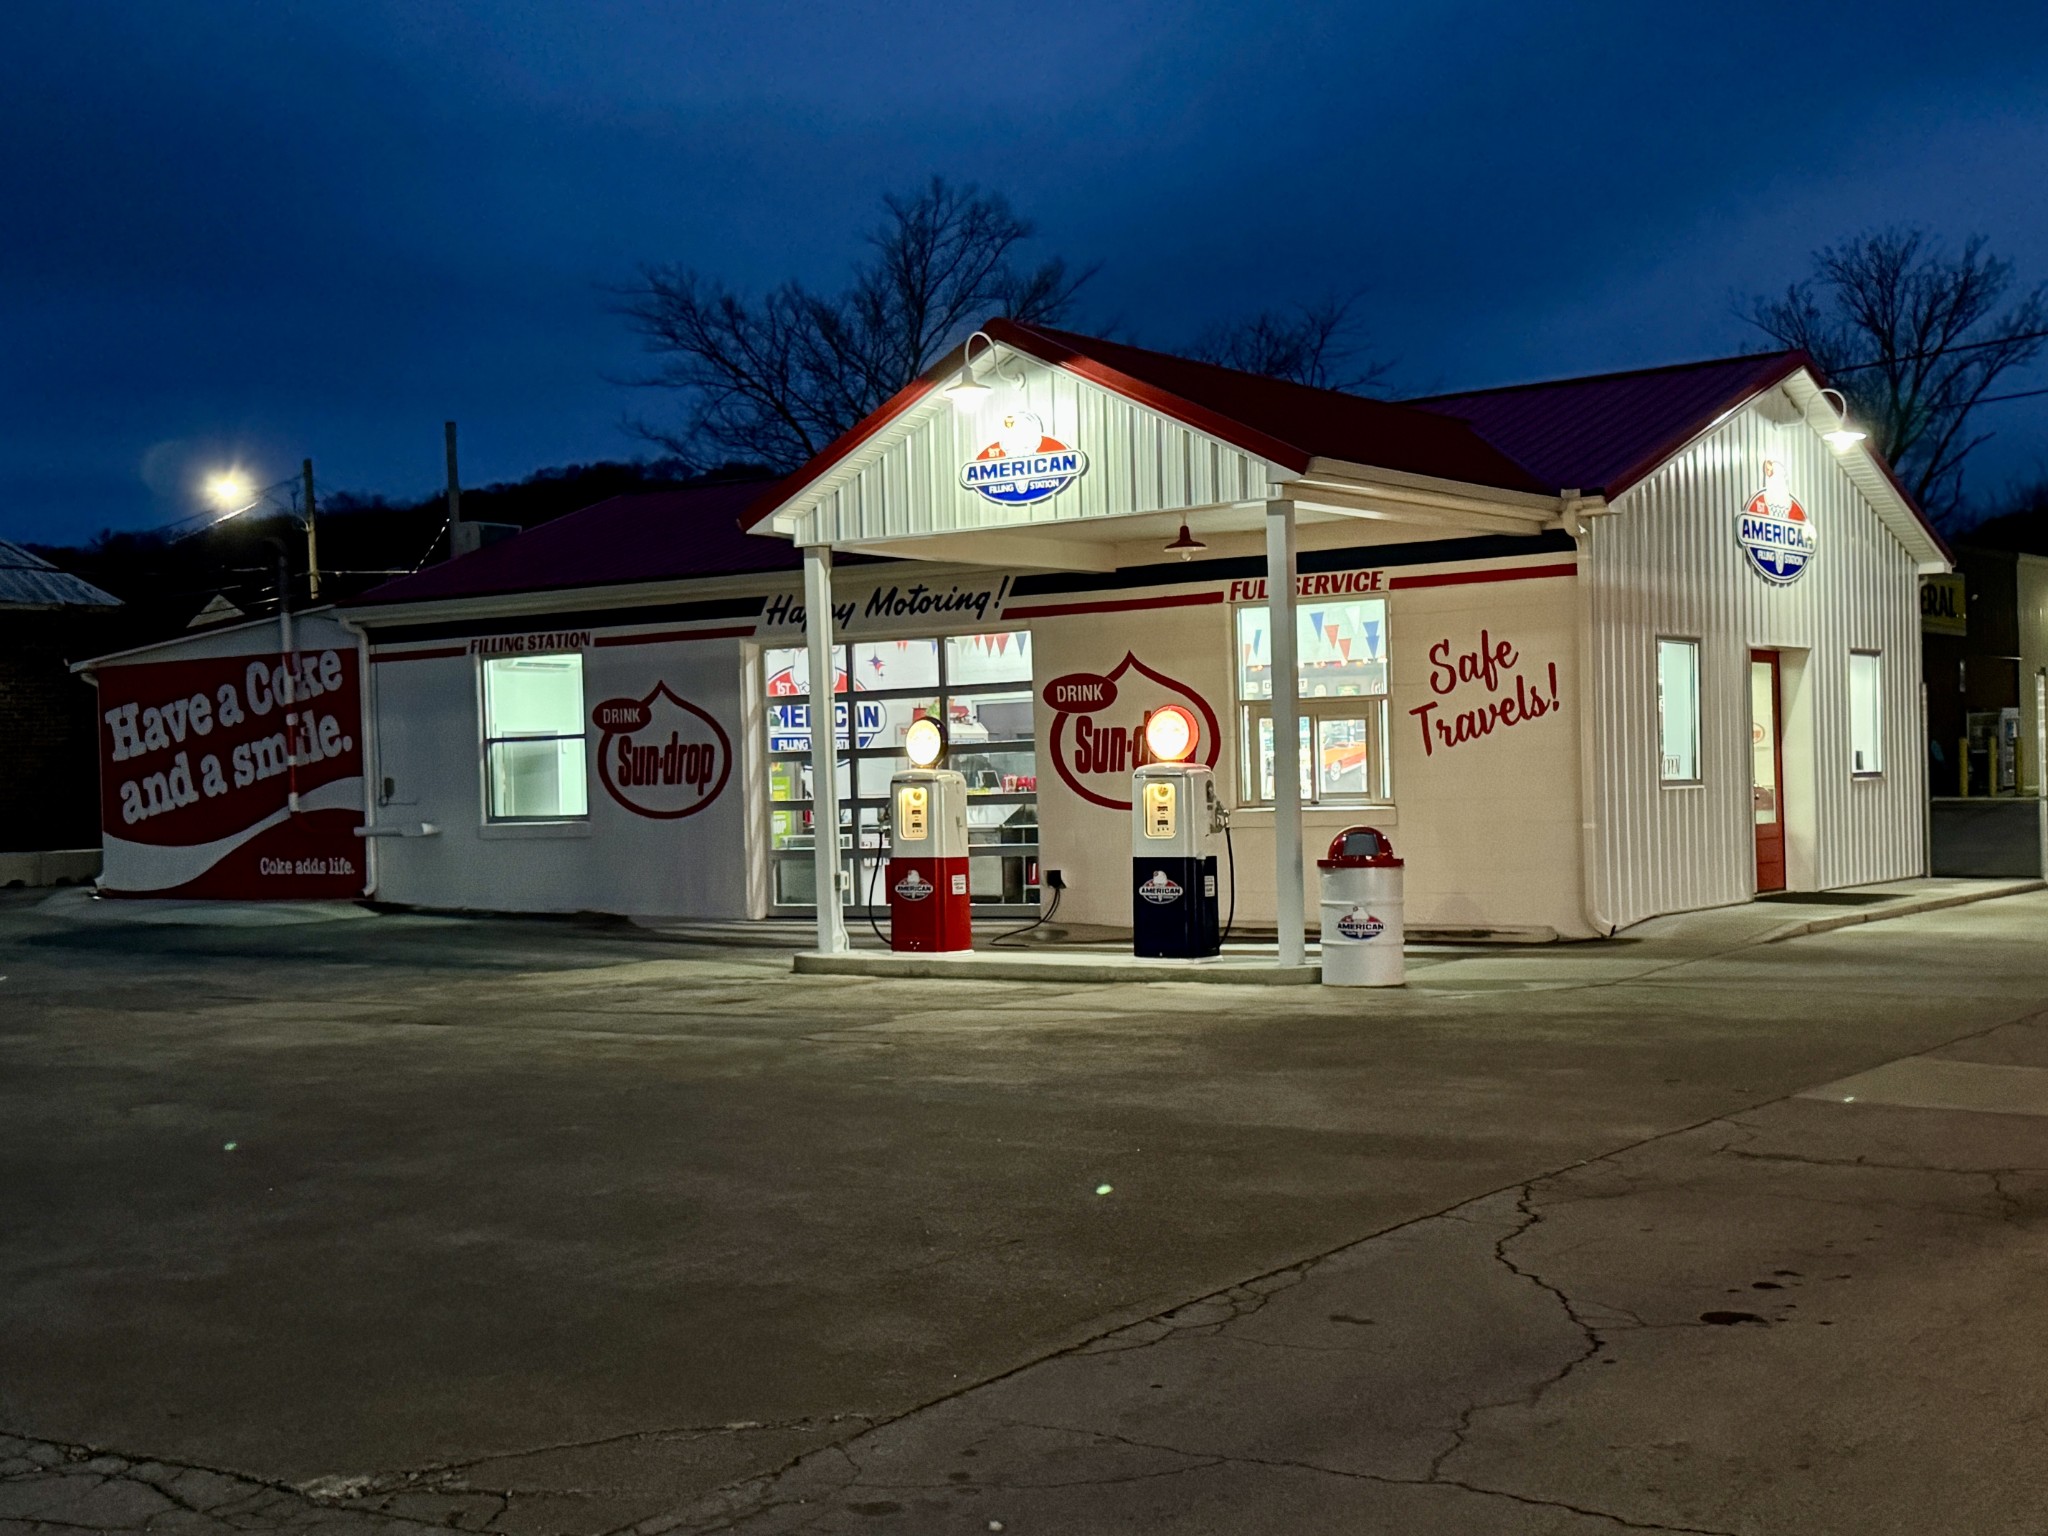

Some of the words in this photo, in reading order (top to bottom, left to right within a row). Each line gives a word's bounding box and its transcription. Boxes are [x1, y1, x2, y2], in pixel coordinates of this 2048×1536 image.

[967, 454, 1077, 482] AMERICAN
[989, 484, 1014, 494] FILLING
[1030, 479, 1060, 490] STATION
[1229, 579, 1269, 602] FUL
[766, 594, 856, 633] Hay
[865, 575, 1010, 620] Motoring!
[470, 636, 524, 654] FILLING
[528, 631, 591, 650] STATION
[1429, 629, 1519, 694] Safe
[1056, 683, 1104, 703] DRINK
[105, 692, 213, 761] Have
[217, 684, 244, 727] a
[246, 650, 343, 715] Coke
[603, 708, 641, 724] DRINK
[1408, 662, 1560, 757] Travels!
[1075, 710, 1196, 774] Sun-d
[120, 751, 199, 825] and
[200, 754, 228, 797] a
[232, 709, 353, 789] smile.
[260, 857, 293, 875] Coke
[295, 858, 326, 875] adds
[328, 857, 356, 875] life.
[1141, 887, 1181, 895] AMERICAN
[1337, 922, 1384, 931] AMERICAN
